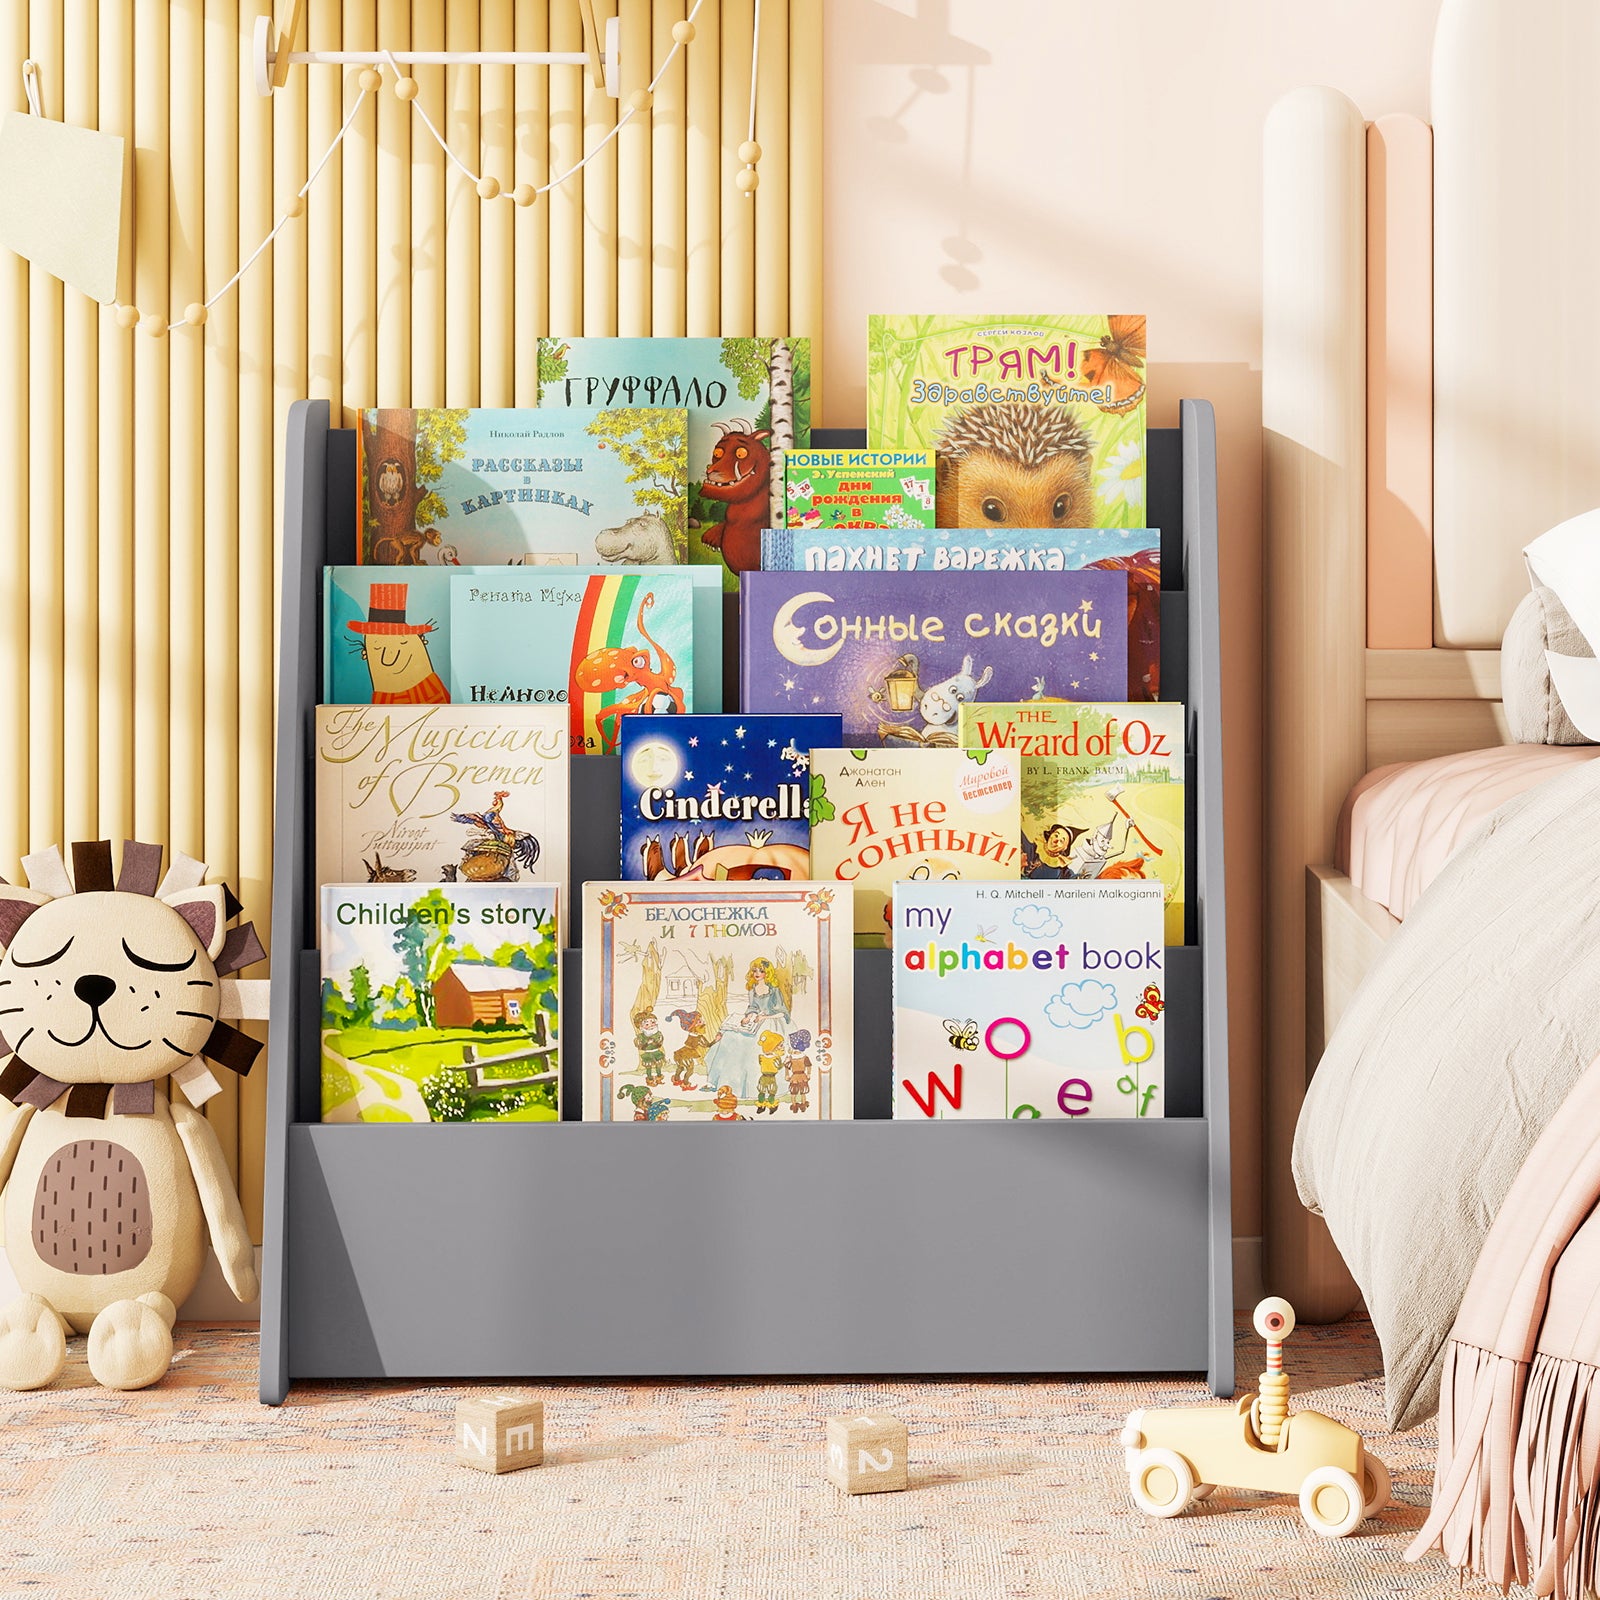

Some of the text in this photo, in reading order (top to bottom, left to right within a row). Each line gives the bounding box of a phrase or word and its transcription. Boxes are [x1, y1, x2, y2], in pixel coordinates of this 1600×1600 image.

[945, 342, 1077, 380] ТРЯМ!
[564, 375, 727, 408] ГРУФФАЛО
[910, 380, 1112, 406] Здравствуйте!
[489, 429, 566, 439] Николай Радлов
[471, 458, 583, 473] РАССКАЗЫ
[786, 453, 927, 466] НОВЫЕ ИСТОРИИ
[826, 468, 896, 479] Успенский
[460, 488, 594, 516] КАРТИНКАХ
[811, 494, 903, 506] рождения
[470, 587, 582, 606] Рената Муха
[1016, 711, 1057, 723] THE
[320, 706, 563, 764] The Musicians
[976, 718, 1171, 758] Wizard of Oz
[839, 766, 902, 778] Джонатан
[855, 778, 886, 787] Ален
[1026, 766, 1124, 775] BY L. FRANK BAUM
[349, 752, 545, 819] of Bremen
[841, 800, 947, 847] Я не
[835, 829, 1018, 881] сонный!
[976, 890, 988, 899] H.
[990, 890, 1002, 900] Q.
[1005, 889, 1045, 899] Mitchell
[1054, 889, 1096, 899] Marileni
[1098, 889, 1161, 901] Malkogianni
[336, 902, 546, 930] Children's story
[645, 906, 769, 922] БЕЛОСНЕЖКА
[905, 907, 952, 935] my
[659, 922, 778, 939] И 7 ГНОМОВ
[904, 941, 1163, 978] alphabet book
[1113, 1013, 1154, 1066] b
[1057, 1078, 1092, 1116] e
